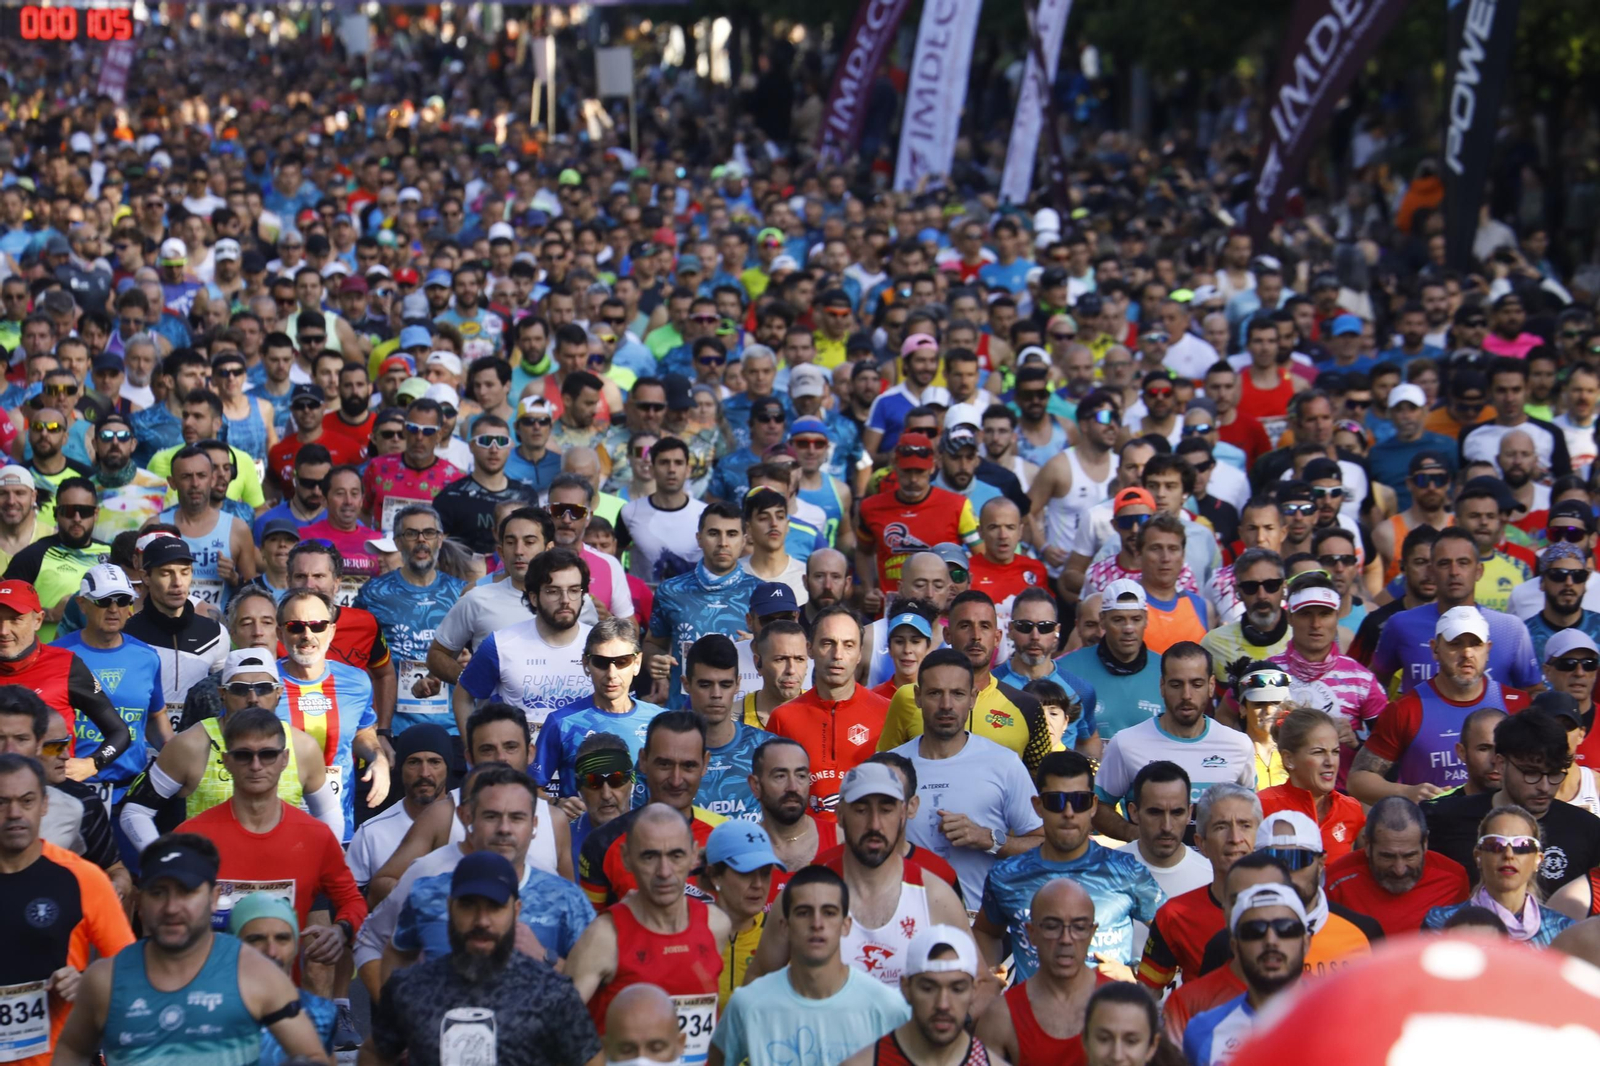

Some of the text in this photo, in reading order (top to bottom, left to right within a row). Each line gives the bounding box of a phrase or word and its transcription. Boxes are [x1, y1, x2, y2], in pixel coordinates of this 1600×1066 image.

[20, 5, 133, 41] 000 105
[522, 674, 593, 687] RUNNERS
[699, 799, 747, 814] MEDIA
[0, 997, 46, 1026] 834
